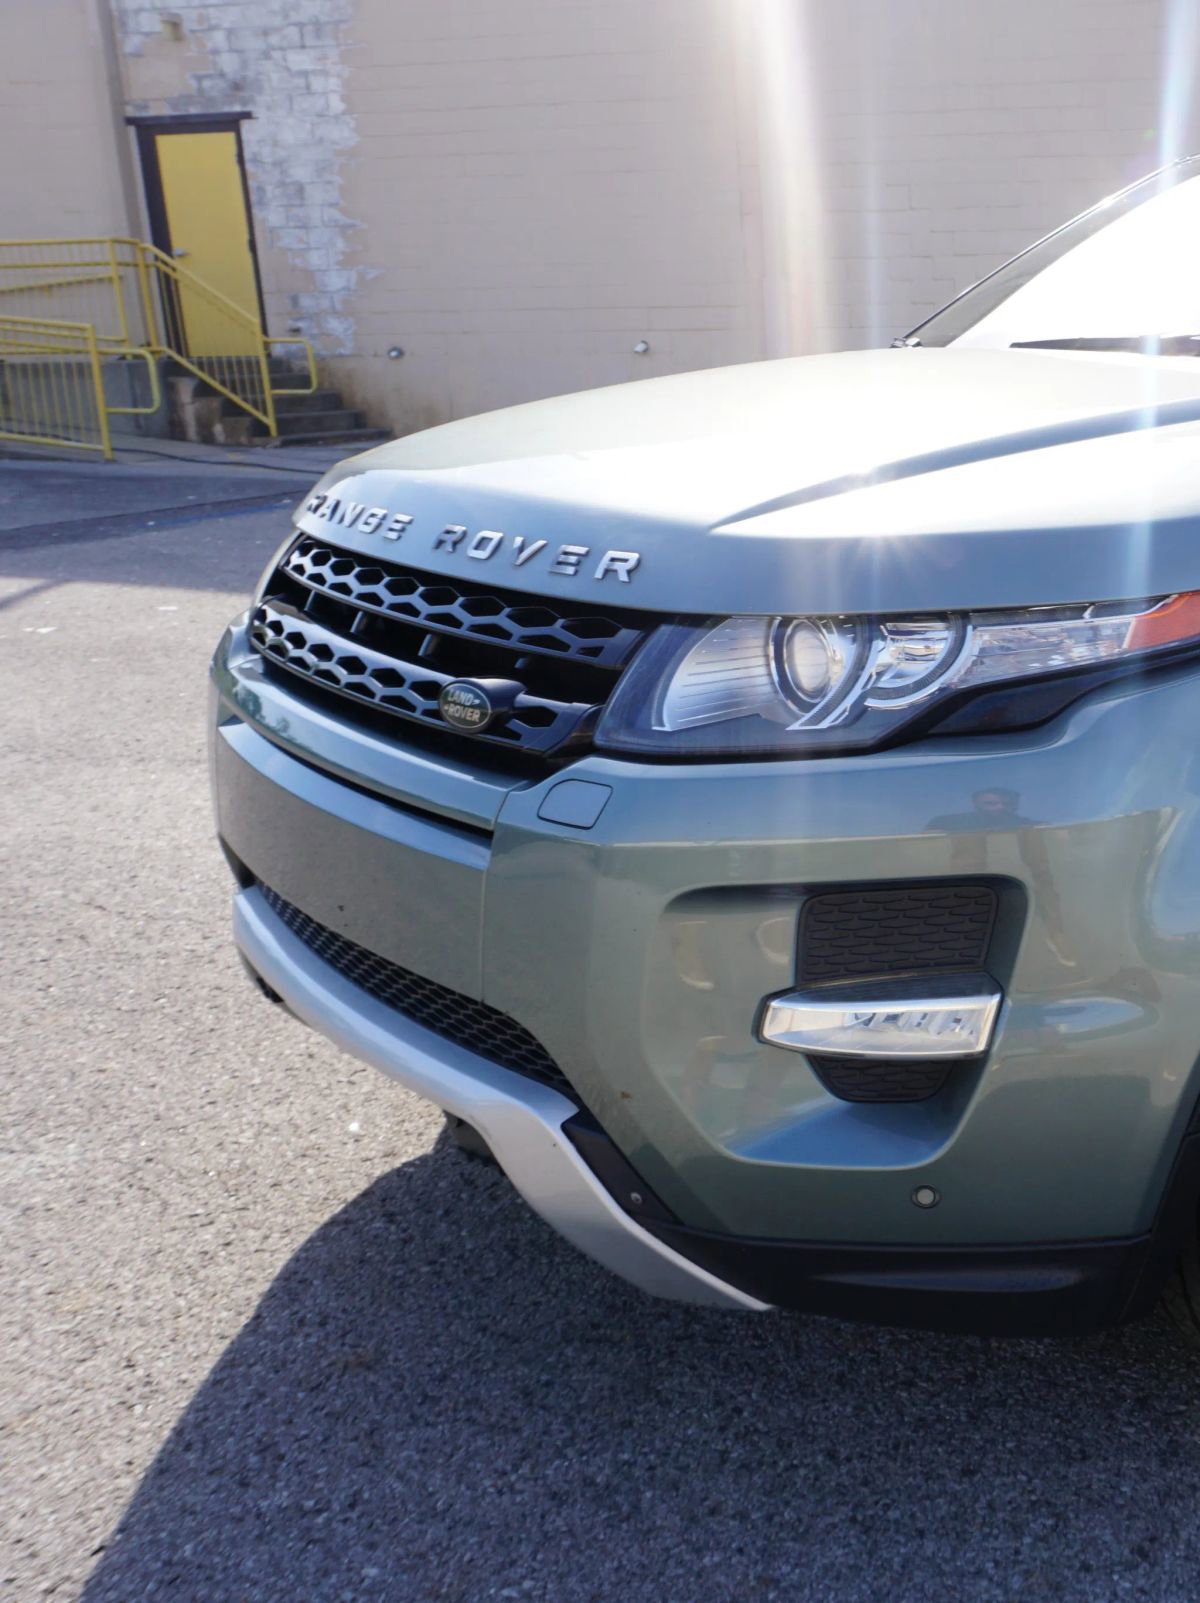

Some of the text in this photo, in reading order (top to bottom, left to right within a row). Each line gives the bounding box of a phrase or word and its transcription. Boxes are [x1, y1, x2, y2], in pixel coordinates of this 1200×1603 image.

[306, 495, 641, 583] RANGE ROVER
[448, 689, 474, 706] LAND
[448, 703, 481, 722] ROVER
